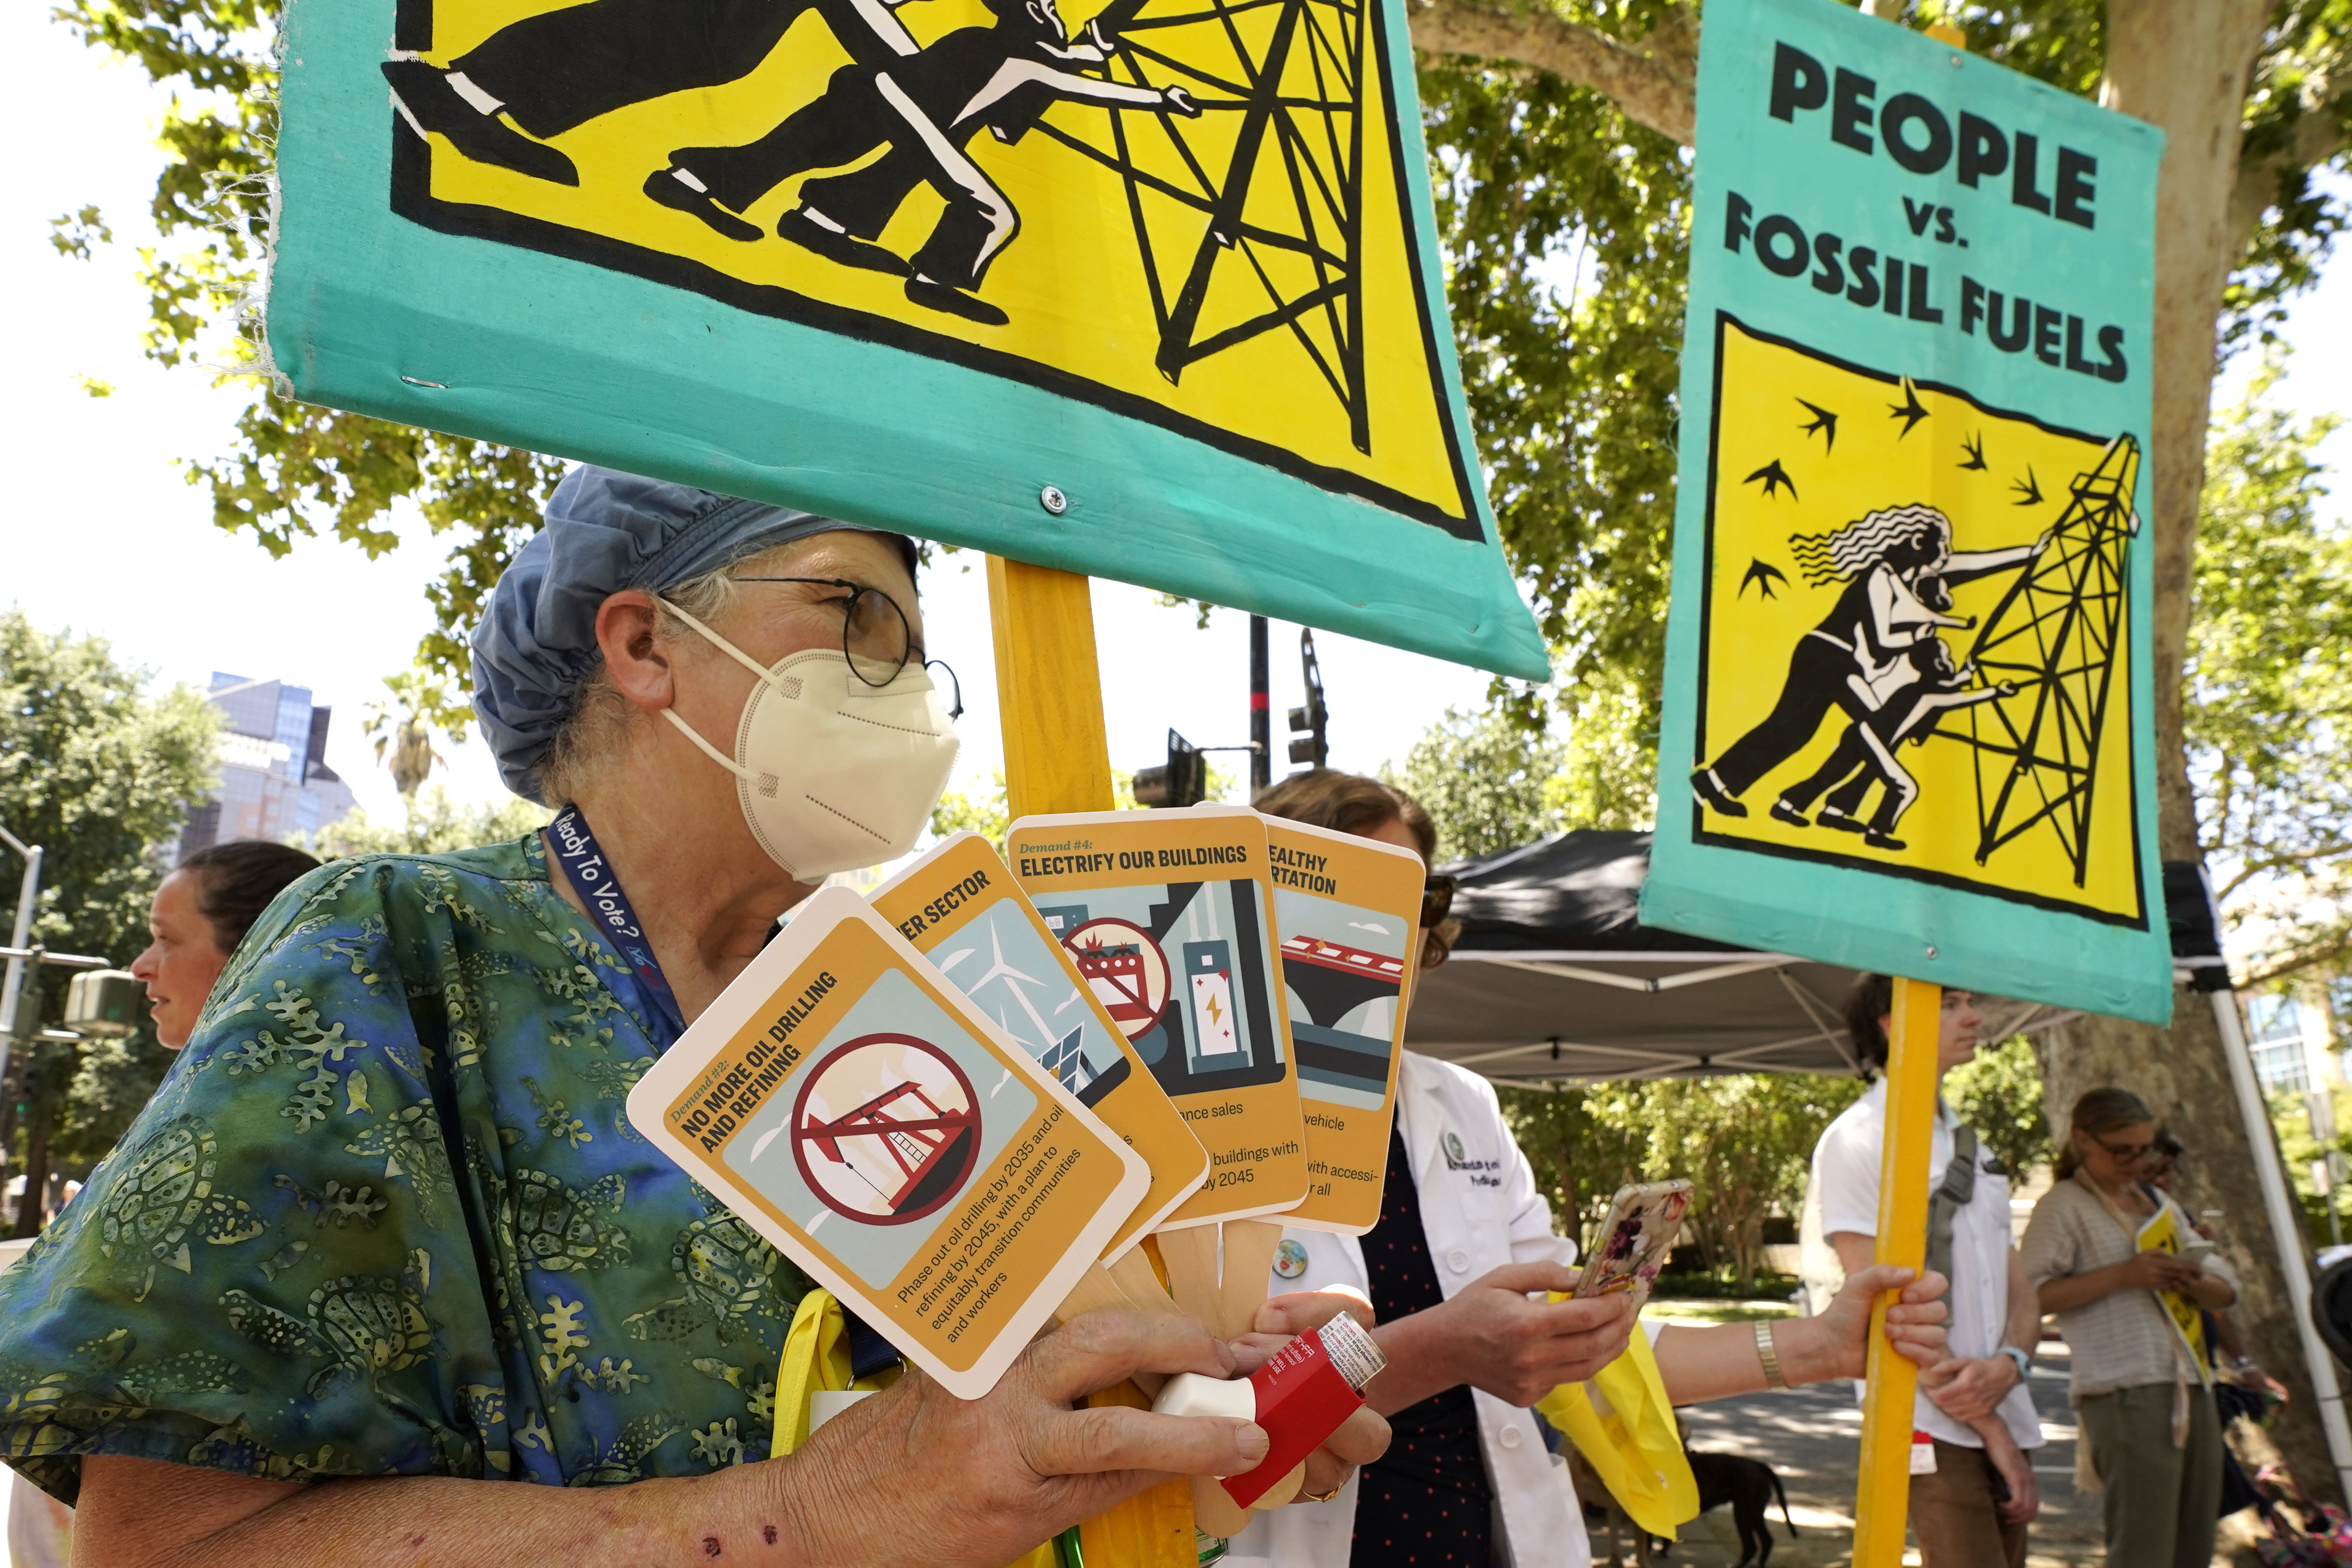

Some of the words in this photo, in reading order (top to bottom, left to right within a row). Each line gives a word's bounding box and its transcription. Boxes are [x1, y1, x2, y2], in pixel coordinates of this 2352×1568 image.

[1769, 41, 2097, 230] PEOPLE
[1724, 191, 1943, 325] FOSSIL
[1960, 275, 2128, 383] FUELS
[1019, 841, 1071, 853] Demand
[1073, 840, 1092, 850] #4:
[1269, 845, 1328, 873] EALTHY
[1021, 854, 1114, 876] ELECTRIFY
[1120, 851, 1155, 869] OUR
[1158, 846, 1247, 866] BUILDINGS
[555, 812, 590, 857] Ready
[577, 855, 602, 880] To
[592, 881, 639, 937] Vote?
[1271, 865, 1336, 896] RTATION
[896, 914, 928, 942] ER
[924, 870, 991, 923] SECTOR
[681, 1110, 709, 1138] NO
[703, 1063, 753, 1114] MORE
[746, 1040, 777, 1067] OIL
[768, 971, 837, 1043] DRILLING
[671, 1075, 713, 1123] Demand
[712, 1061, 729, 1079] #2:
[700, 1115, 736, 1153] AND
[729, 1044, 801, 1119] REFINING
[1212, 1102, 1243, 1117] sales
[1305, 1114, 1344, 1130] vehicle
[1214, 1148, 1269, 1165] buildings
[1272, 1141, 1298, 1156] with
[1219, 1169, 1253, 1186] 2045
[1330, 1167, 1378, 1182] accessi-
[1317, 1183, 1330, 1196] all
[898, 1266, 932, 1303] Phase
[931, 1244, 951, 1265] out
[949, 1228, 963, 1245] oil
[961, 1189, 998, 1230] drilling
[991, 1175, 1008, 1192] by
[1005, 1141, 1034, 1177] 2035
[1033, 1119, 1052, 1144] and
[1051, 1104, 1063, 1121] oil
[916, 1270, 957, 1316] refining
[950, 1255, 968, 1272] by
[964, 1220, 1000, 1256] 2045,
[996, 1194, 1020, 1219] with
[1018, 1185, 1027, 1194] a
[1025, 1160, 1047, 1187] plan
[1044, 1147, 1056, 1159] to
[932, 1275, 978, 1329] equitably
[975, 1221, 1024, 1275] transition
[1022, 1150, 1080, 1221] communities
[948, 1316, 969, 1343] and
[966, 1273, 1007, 1318] workers
[1355, 1336, 1363, 1345] Each
[1275, 1358, 1287, 1371] WELL
[1283, 1351, 1297, 1366] Aerosol
[1289, 1346, 1305, 1363] sulfate)
[1333, 1358, 1342, 1369] insert
[1336, 1355, 1347, 1367] medical
[1271, 1363, 1281, 1375] USE
